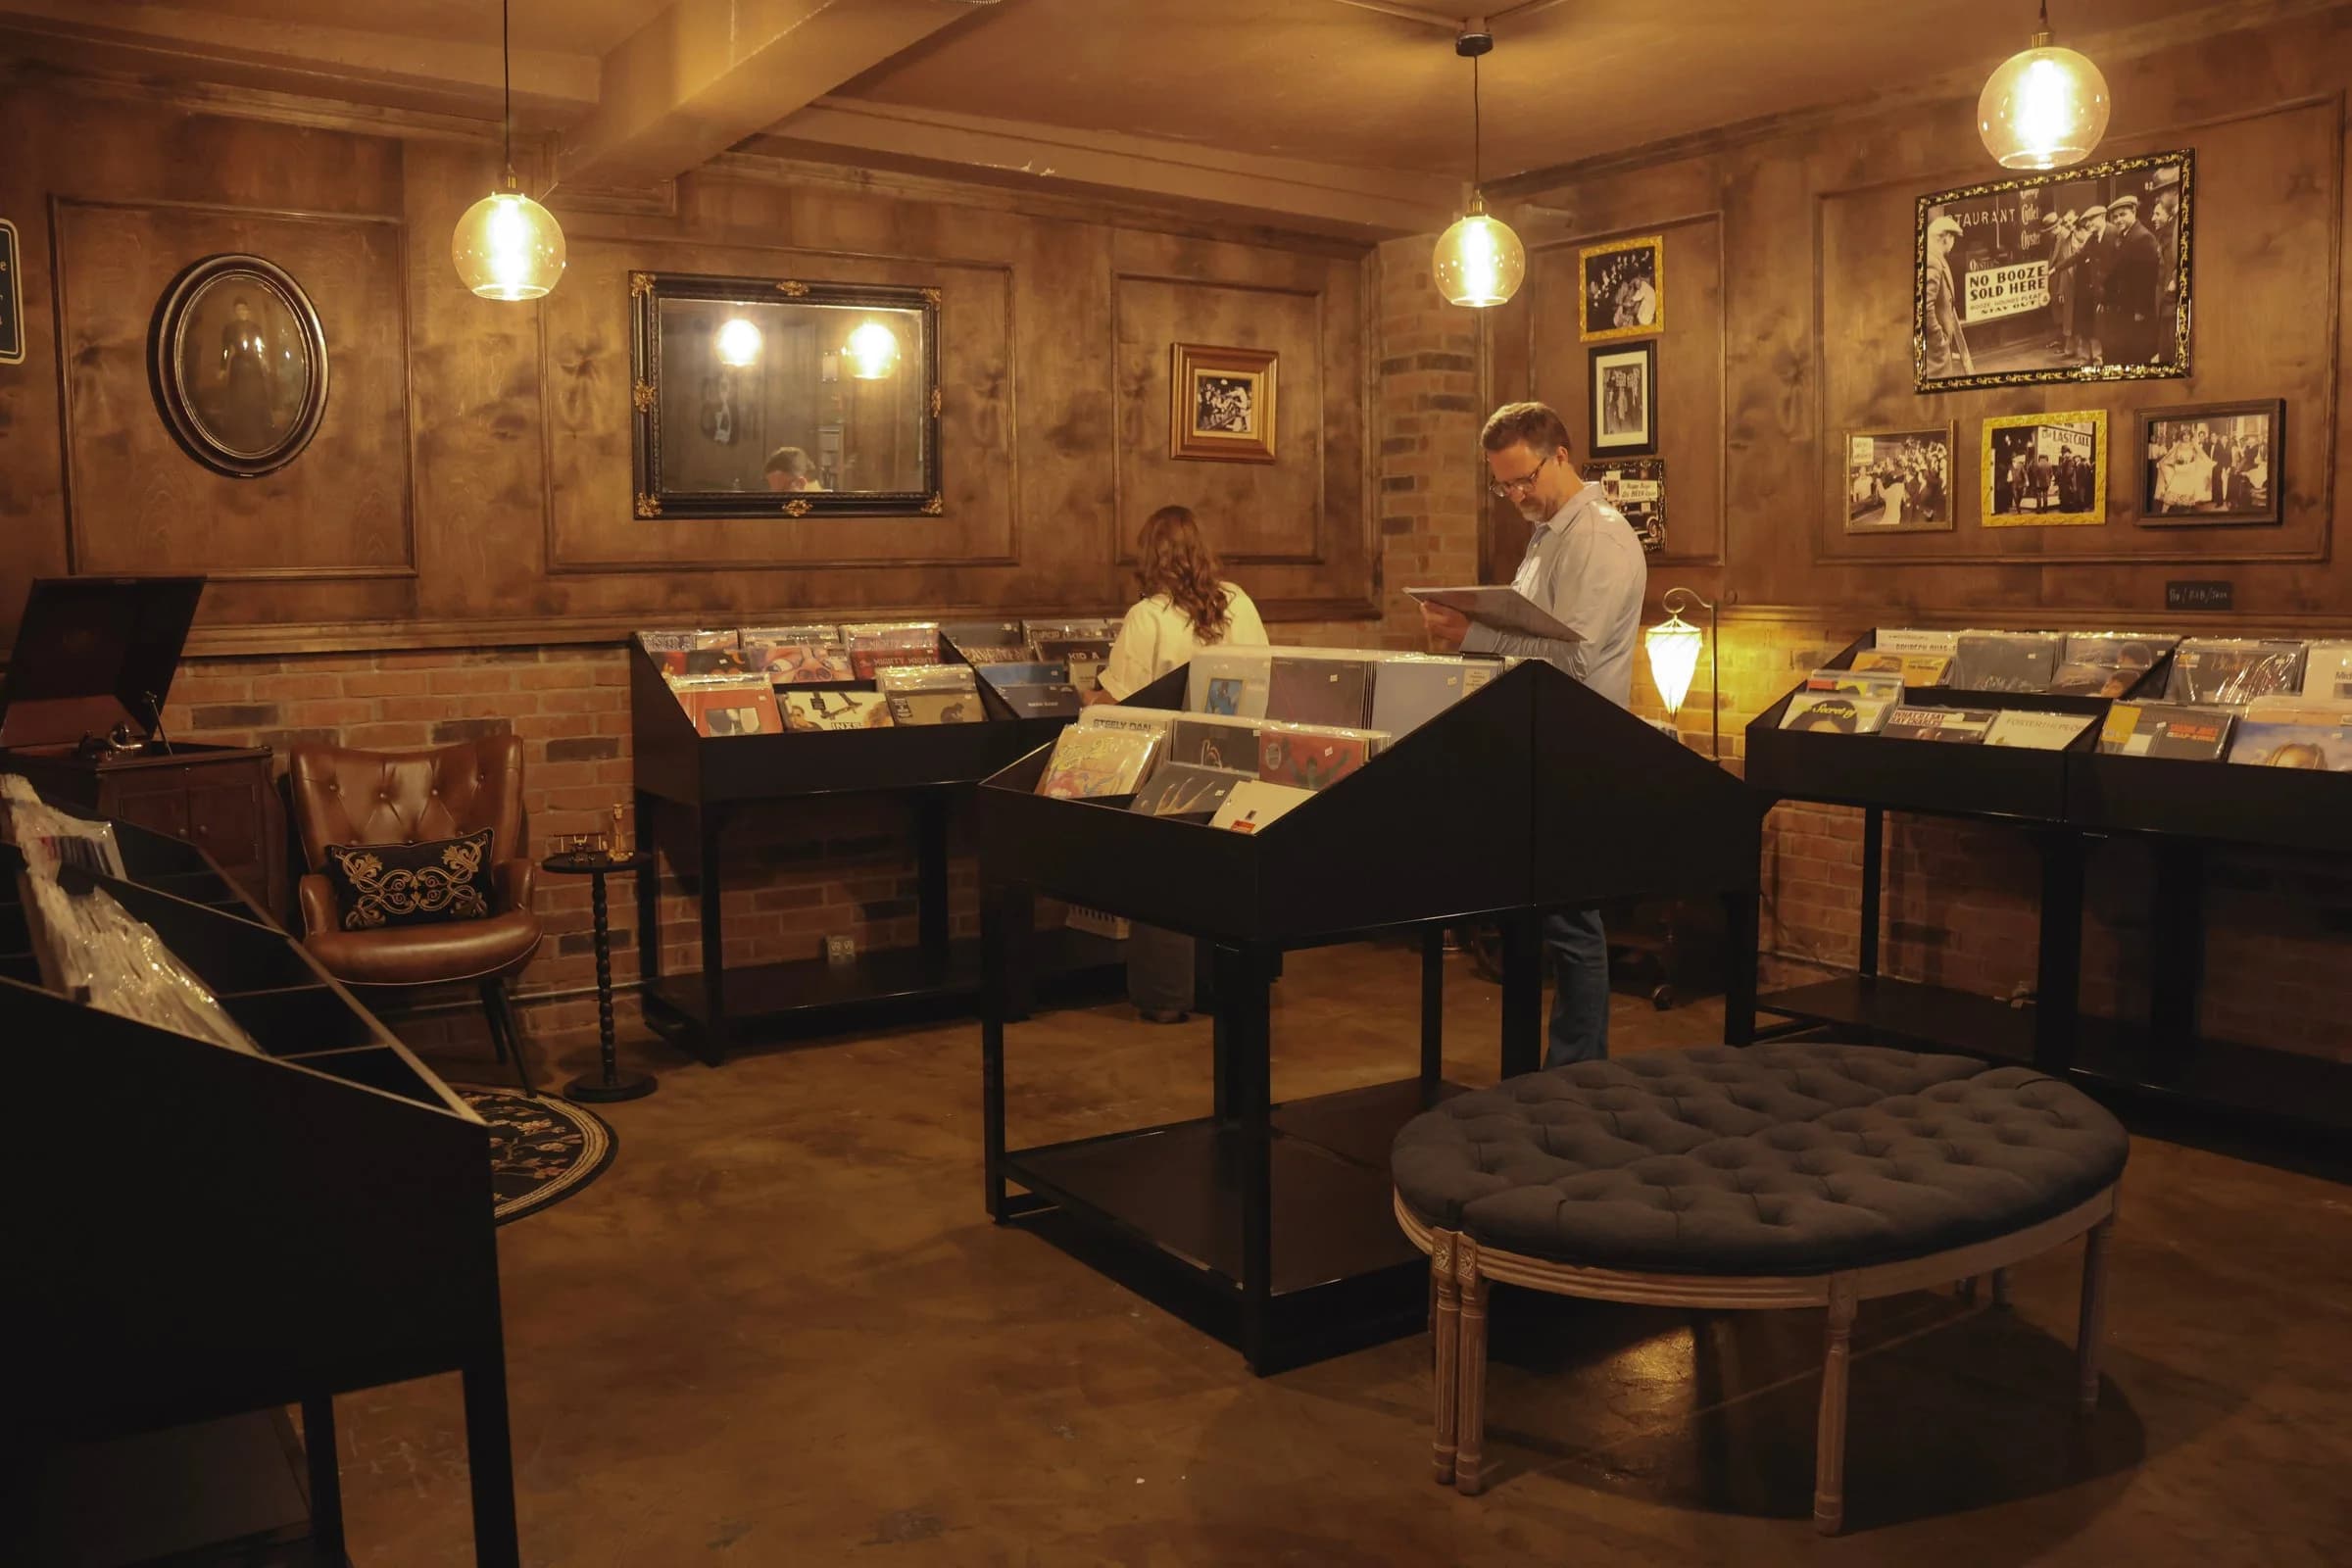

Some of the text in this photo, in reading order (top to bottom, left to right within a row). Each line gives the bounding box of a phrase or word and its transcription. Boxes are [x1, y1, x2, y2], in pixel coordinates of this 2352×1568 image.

[1948, 209, 2015, 227] TAURANT
[1970, 266, 2046, 288] NO BOOZE
[1970, 278, 2046, 301] SOLD HERE
[1981, 300, 2035, 315] STAY OUT
[2053, 430, 2073, 444] LAST
[2074, 434, 2090, 447] CALL
[1094, 718, 1152, 731] STEELY DAN
